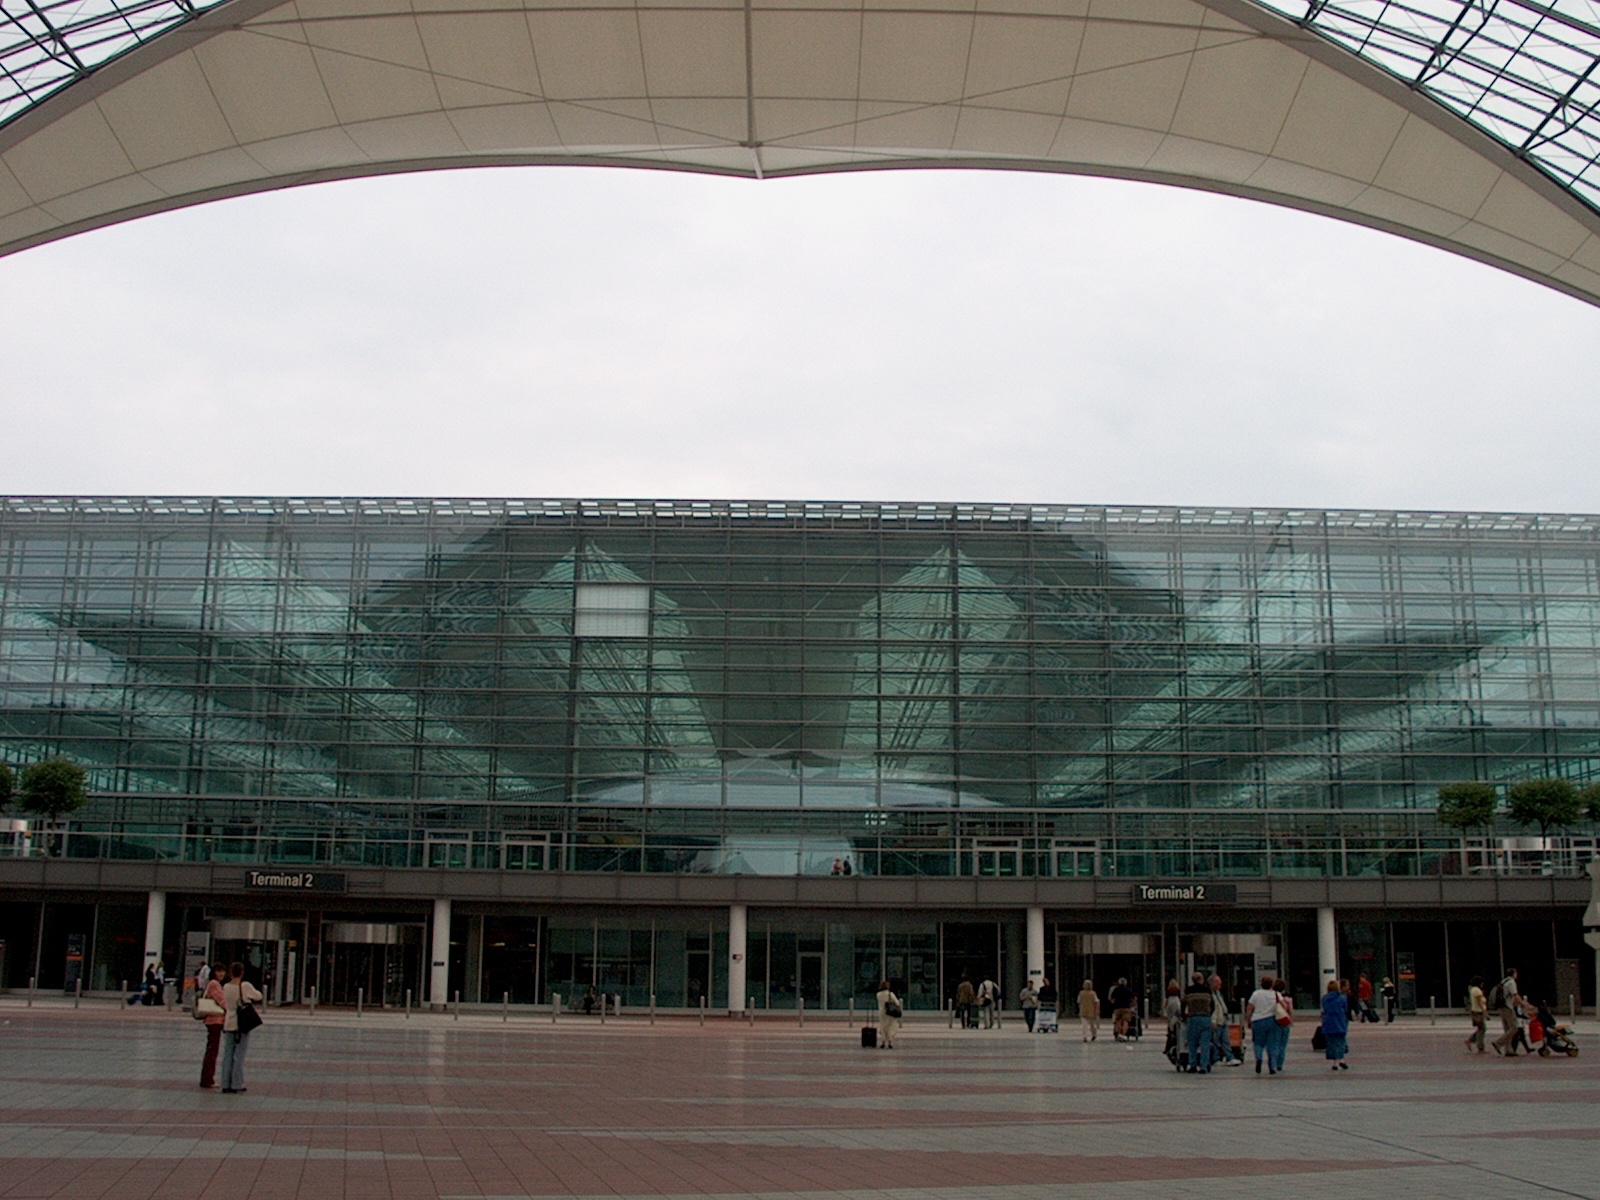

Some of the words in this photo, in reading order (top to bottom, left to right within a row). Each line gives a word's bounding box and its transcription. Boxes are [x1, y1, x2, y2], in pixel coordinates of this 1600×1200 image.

[250, 871, 303, 887] Terminal
[304, 873, 314, 888] 2
[1140, 884, 1195, 900] Terminal
[1195, 885, 1205, 900] 2
